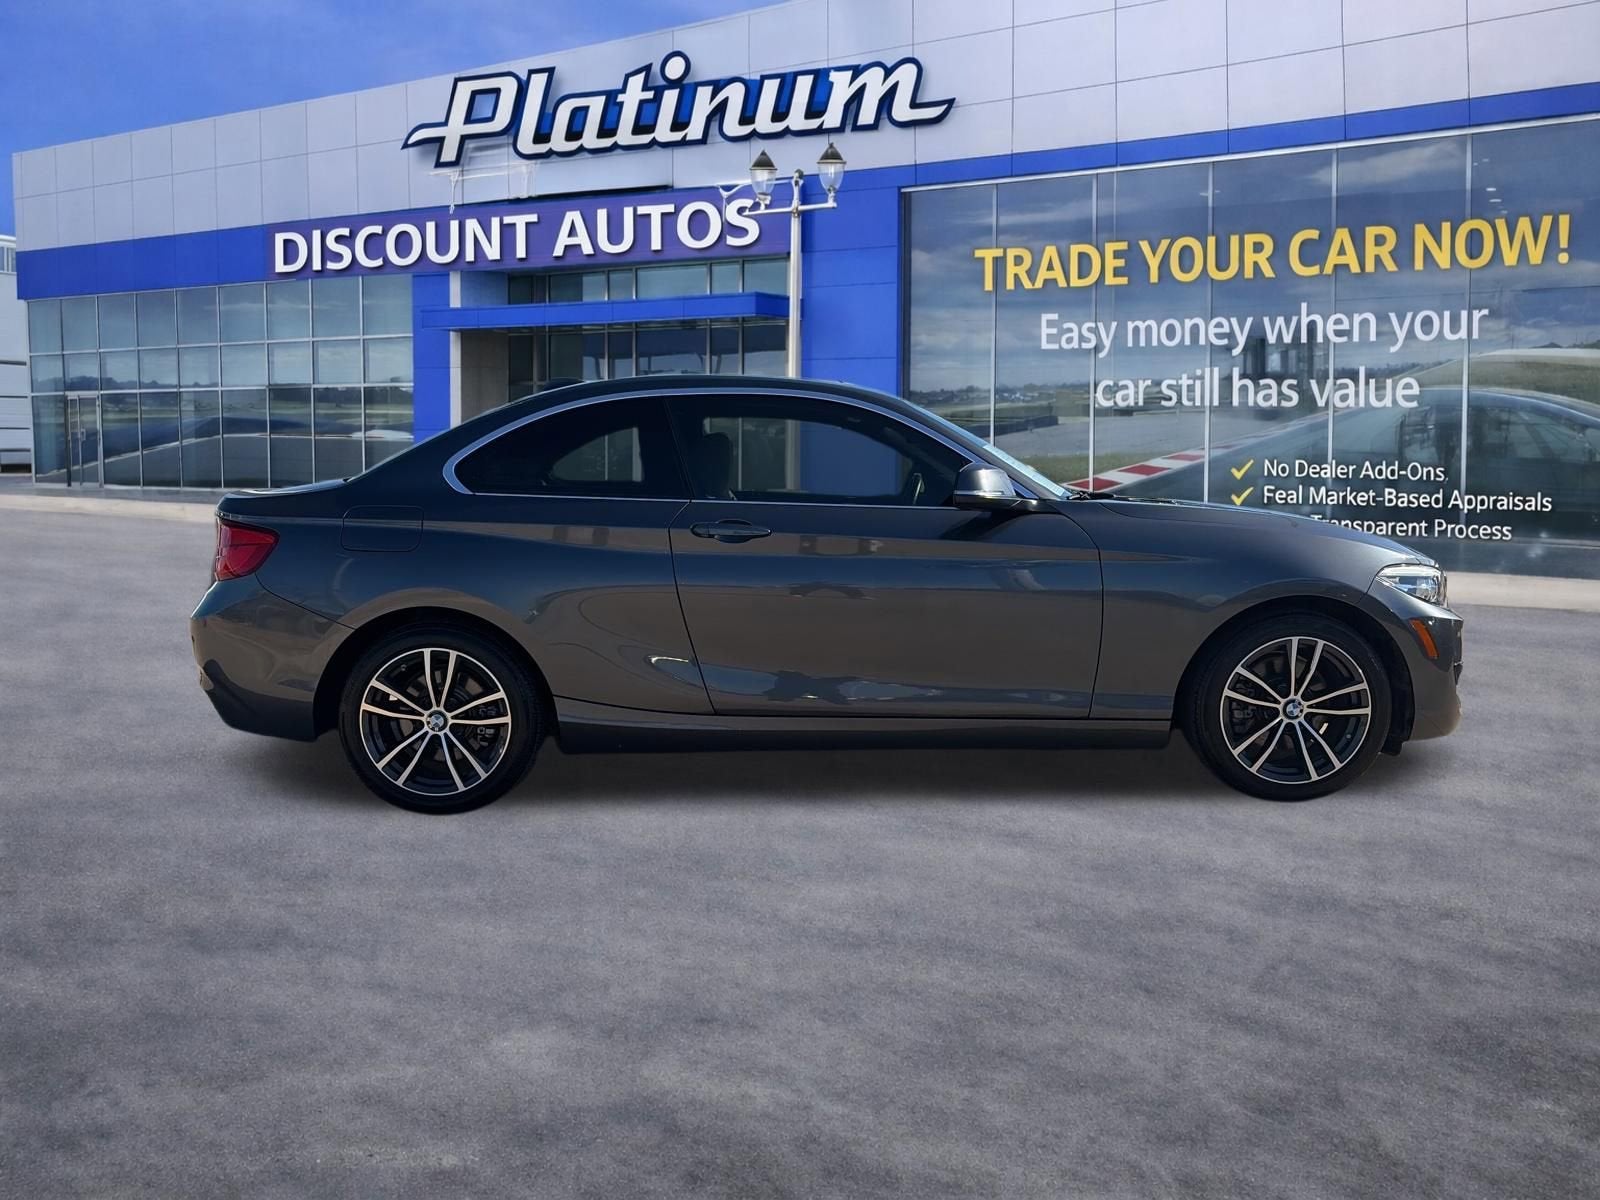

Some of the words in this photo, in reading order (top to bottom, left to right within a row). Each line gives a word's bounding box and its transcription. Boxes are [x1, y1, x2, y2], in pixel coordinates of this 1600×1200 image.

[402, 50, 956, 168] Platinum
[274, 213, 538, 274] DISCOUNT
[552, 197, 762, 258] AUTOS
[974, 240, 1130, 292] TRADE
[1138, 232, 1277, 284] YOUR
[1288, 225, 1399, 276] CAR
[1414, 213, 1572, 271] NOW!
[1040, 312, 1118, 358] Easy
[1126, 315, 1254, 357] money
[1262, 302, 1378, 345] when
[1388, 307, 1490, 355] your
[1095, 374, 1153, 411] car
[1160, 366, 1220, 409] still
[1232, 370, 1300, 409] has
[1309, 369, 1421, 409] value
[1263, 458, 1290, 477] No
[1295, 459, 1357, 479] Dealer
[1263, 484, 1303, 505] Feal
[1308, 485, 1443, 508] Market-Based
[1447, 489, 1553, 514] Appraisals
[1310, 514, 1428, 537] nsparent
[1434, 518, 1513, 541] Process
